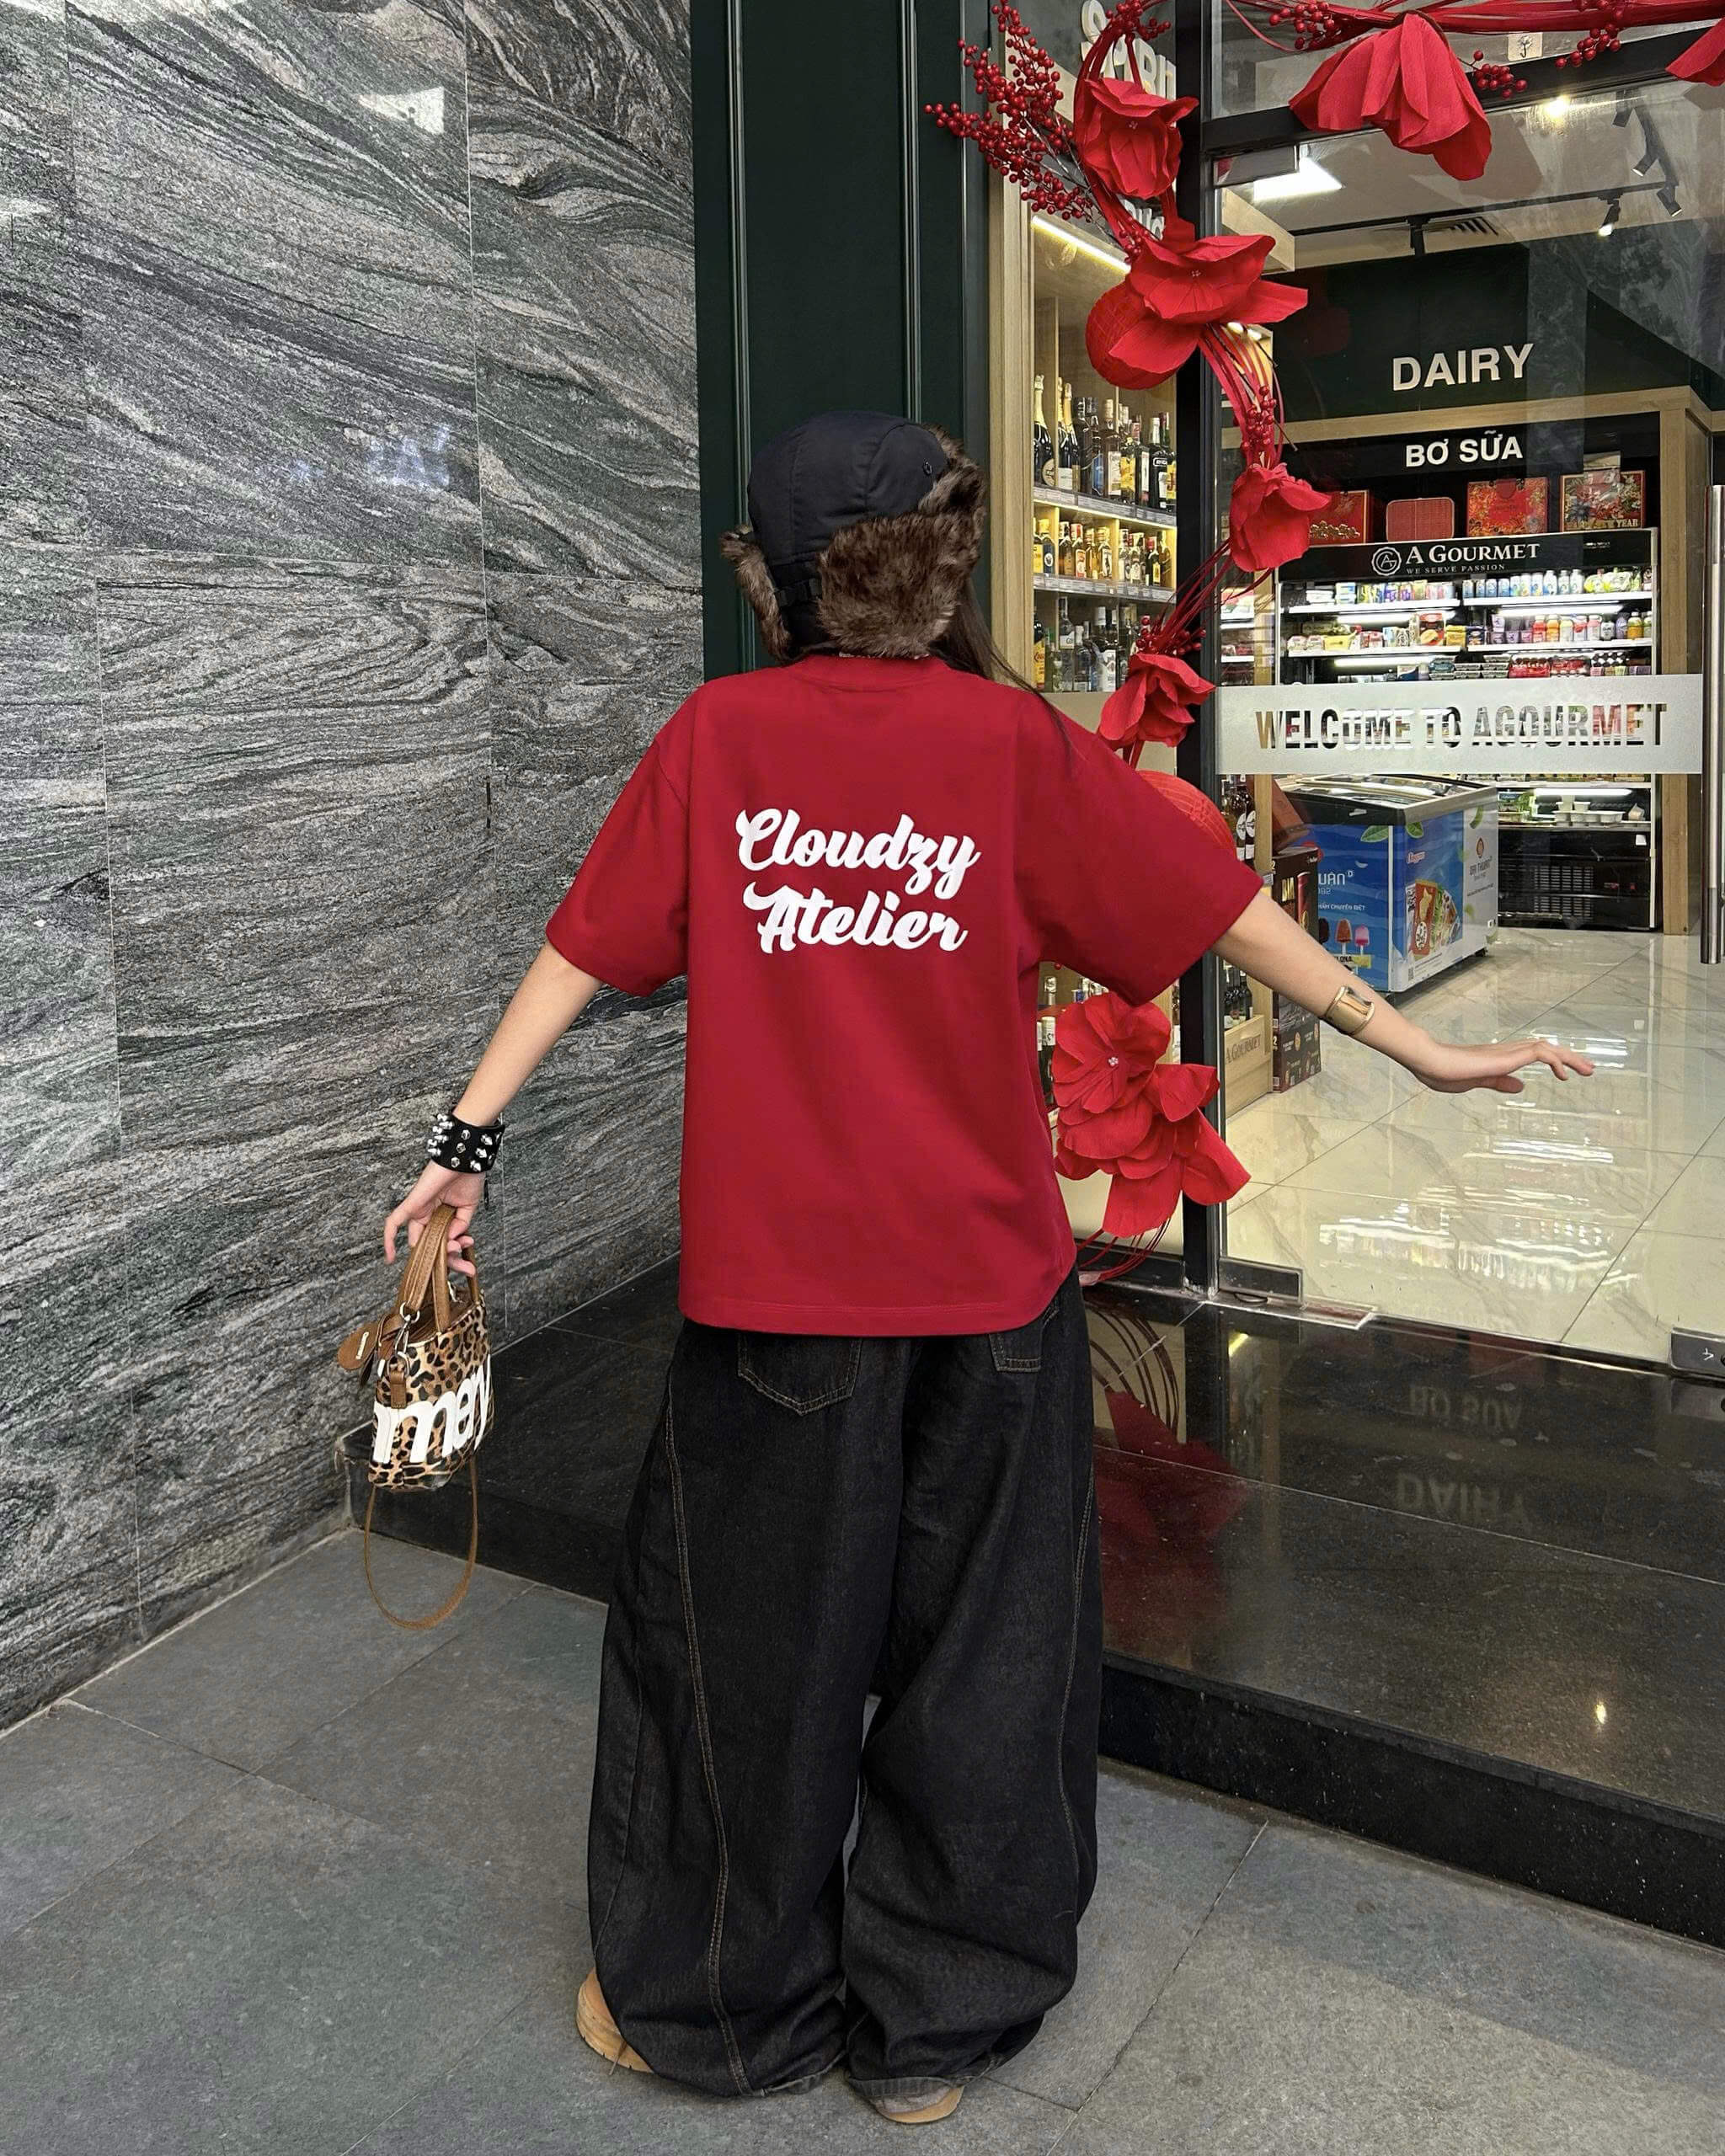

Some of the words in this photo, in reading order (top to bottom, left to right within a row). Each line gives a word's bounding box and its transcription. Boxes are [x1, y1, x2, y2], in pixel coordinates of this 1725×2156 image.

[1392, 343, 1535, 392] DAIRY
[1405, 438, 1450, 468] BƠ
[1458, 430, 1524, 463] SỮA
[1406, 546, 1425, 565] A
[1428, 543, 1541, 563] GOURMET
[1406, 567, 1421, 575] WE
[1424, 565, 1457, 574] SERVE
[1461, 563, 1506, 573] PASSION
[1254, 707, 1415, 750] WELCOME
[1421, 706, 1462, 749] TO
[1471, 703, 1668, 747] AGOURMET
[734, 807, 982, 899] Cloudzy
[742, 881, 969, 954] Atelier
